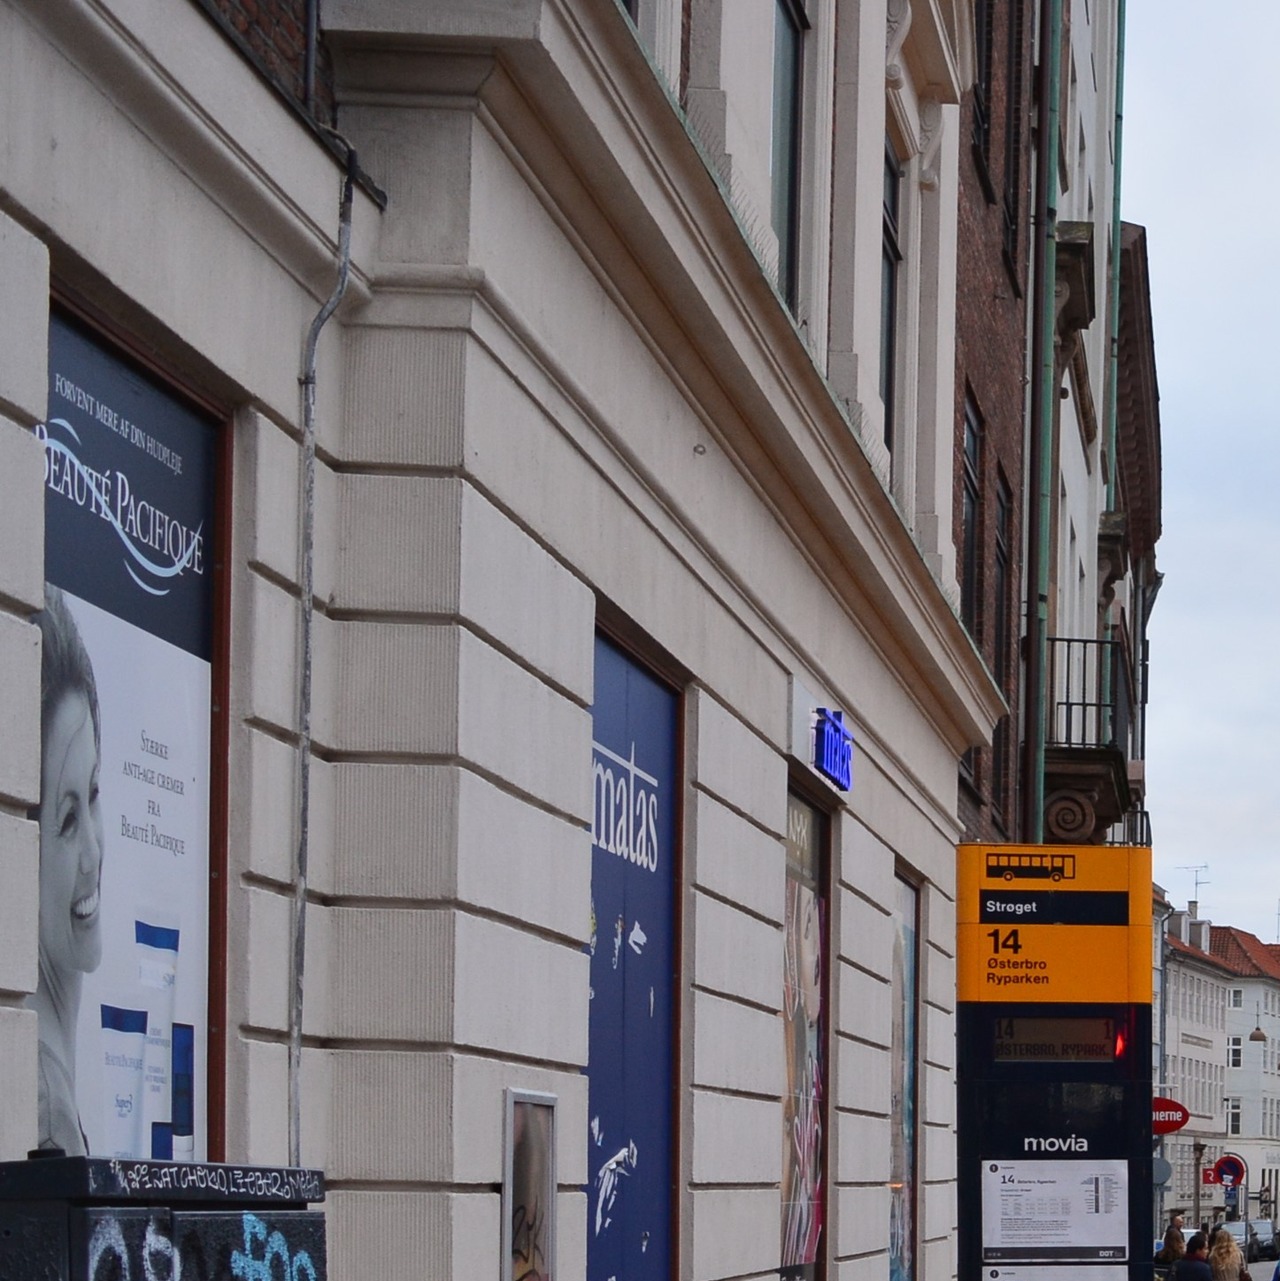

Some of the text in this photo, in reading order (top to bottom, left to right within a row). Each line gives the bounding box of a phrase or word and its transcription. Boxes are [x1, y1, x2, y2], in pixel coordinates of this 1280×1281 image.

[55, 373, 94, 416] FORVENT
[96, 403, 119, 433] MERE
[119, 418, 131, 439] AF
[130, 425, 146, 449] DIN
[115, 470, 204, 576] PACIFIQUE
[816, 708, 853, 792] matas
[157, 772, 184, 795] CREMER
[148, 799, 161, 817] FRA
[150, 824, 185, 856] PACIFIQUE
[986, 900, 1037, 915] Strøget
[987, 929, 1022, 954] 14
[987, 957, 1047, 970] Østerbro
[986, 972, 1049, 985] Ryparken
[995, 1018, 1014, 1039] 14
[1024, 1133, 1088, 1152] movia
[1001, 1174, 1015, 1184] 14
